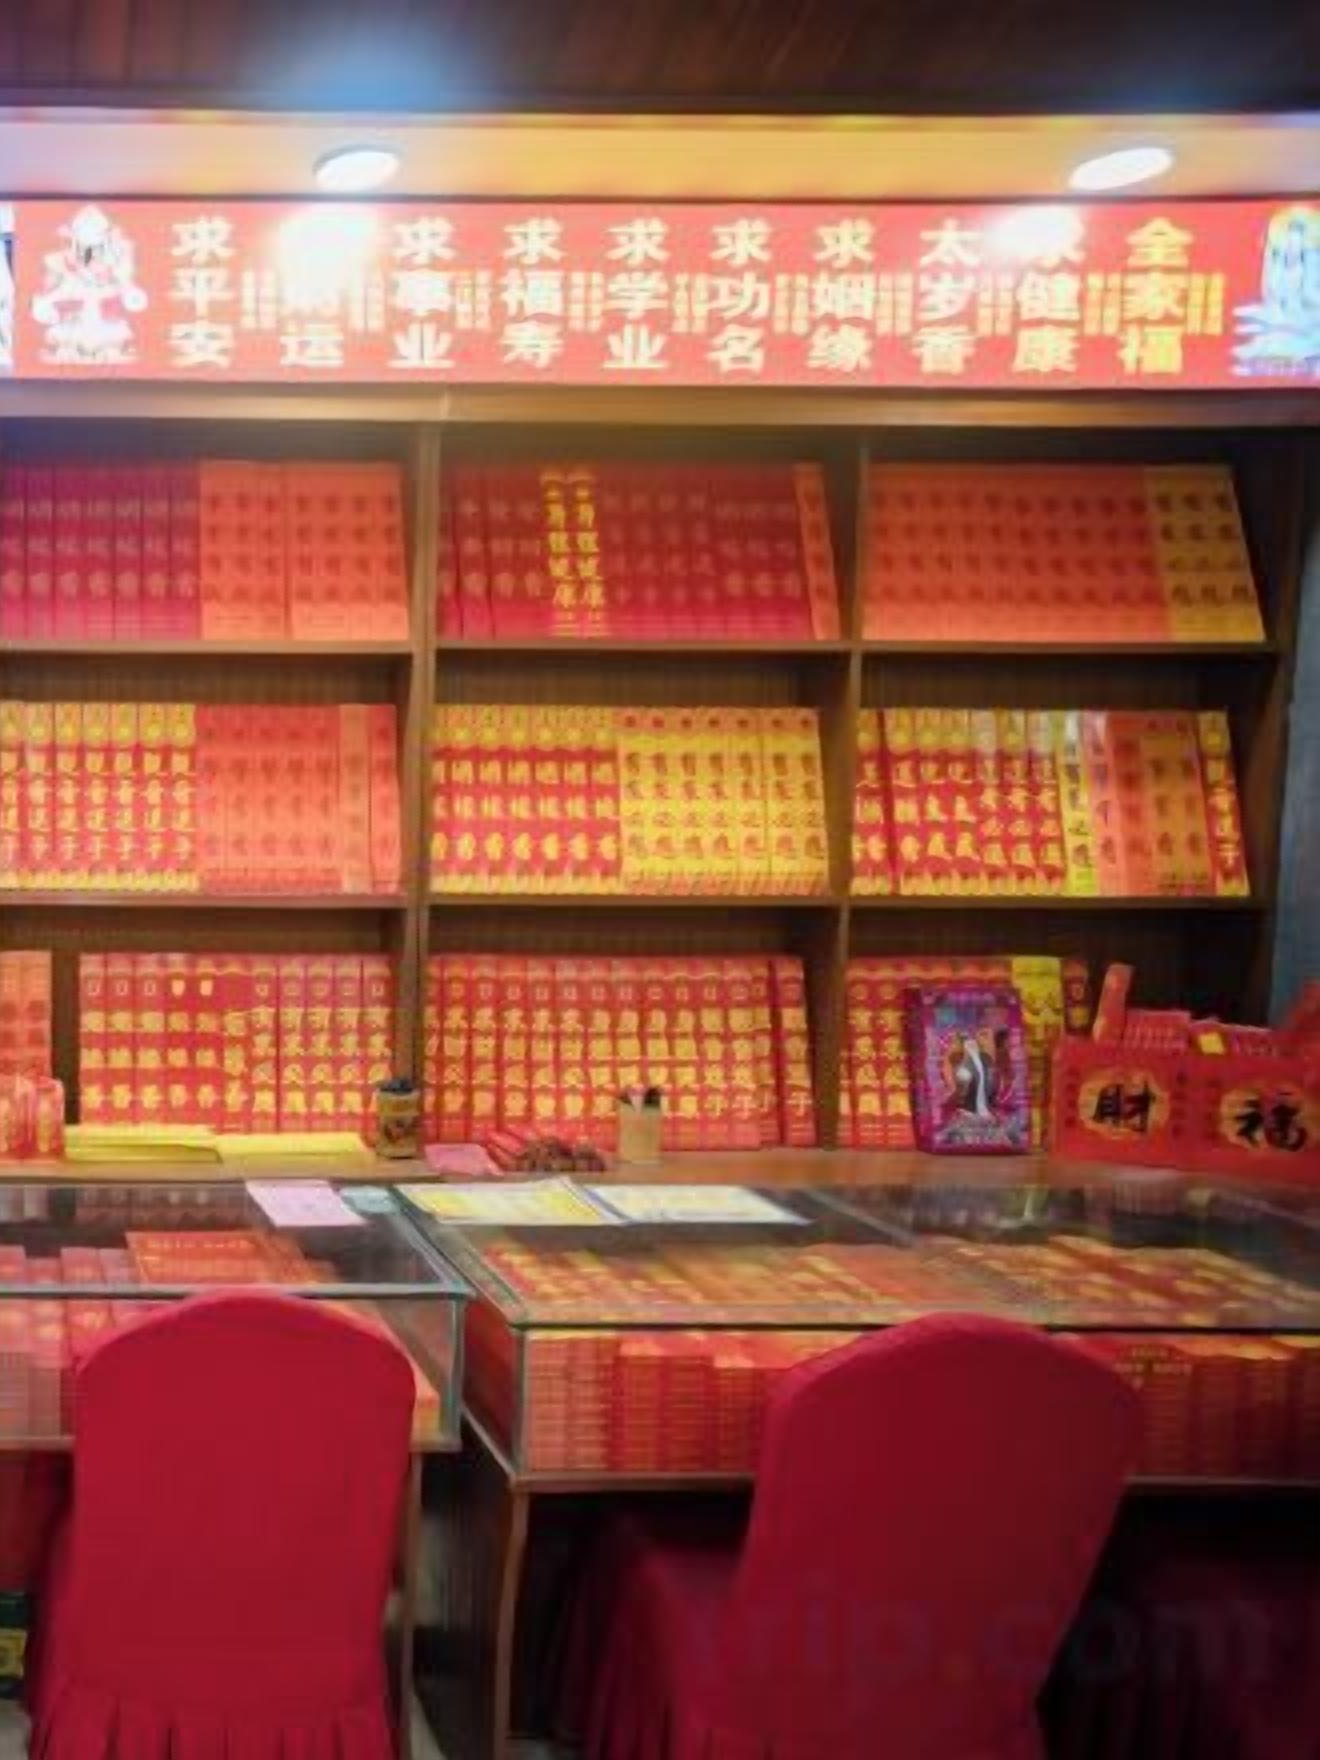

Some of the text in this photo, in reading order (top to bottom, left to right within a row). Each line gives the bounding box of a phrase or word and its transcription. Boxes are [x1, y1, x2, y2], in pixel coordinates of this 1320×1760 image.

[171, 215, 235, 368] 求平安
[388, 217, 456, 369] 求事业
[501, 217, 563, 368] 求福寿
[603, 217, 668, 370] 求学业
[708, 219, 772, 371] 求功名
[807, 219, 874, 372] 求姻缘
[912, 219, 977, 373] 太岁香
[1012, 218, 1084, 373] 健康
[1118, 217, 1193, 375] 全家福
